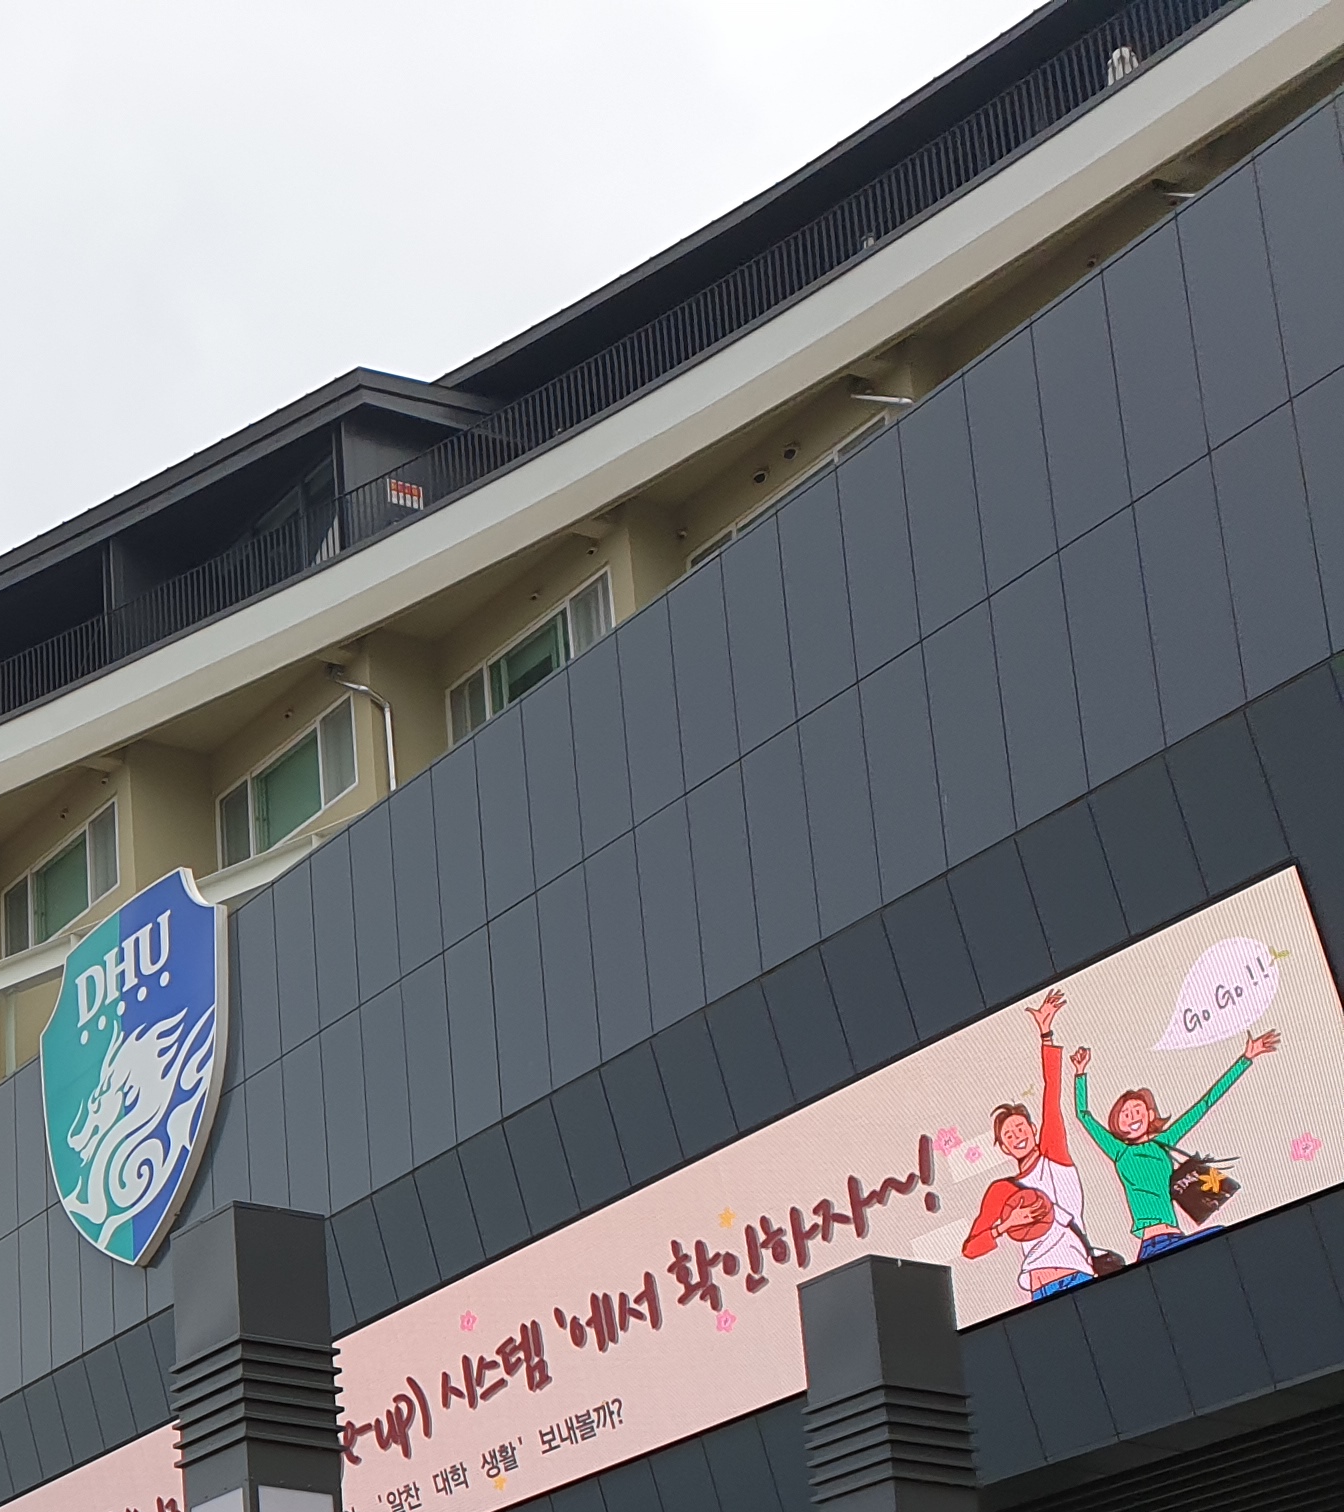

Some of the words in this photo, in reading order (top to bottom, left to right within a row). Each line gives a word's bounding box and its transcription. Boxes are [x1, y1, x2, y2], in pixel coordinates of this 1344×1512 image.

[75, 909, 171, 1028] DHU
[1183, 1008, 1211, 1033] Go
[1215, 984, 1244, 1009] Go
[432, 1461, 470, 1496] 대학
[538, 1398, 624, 1456] 보내볼까?
